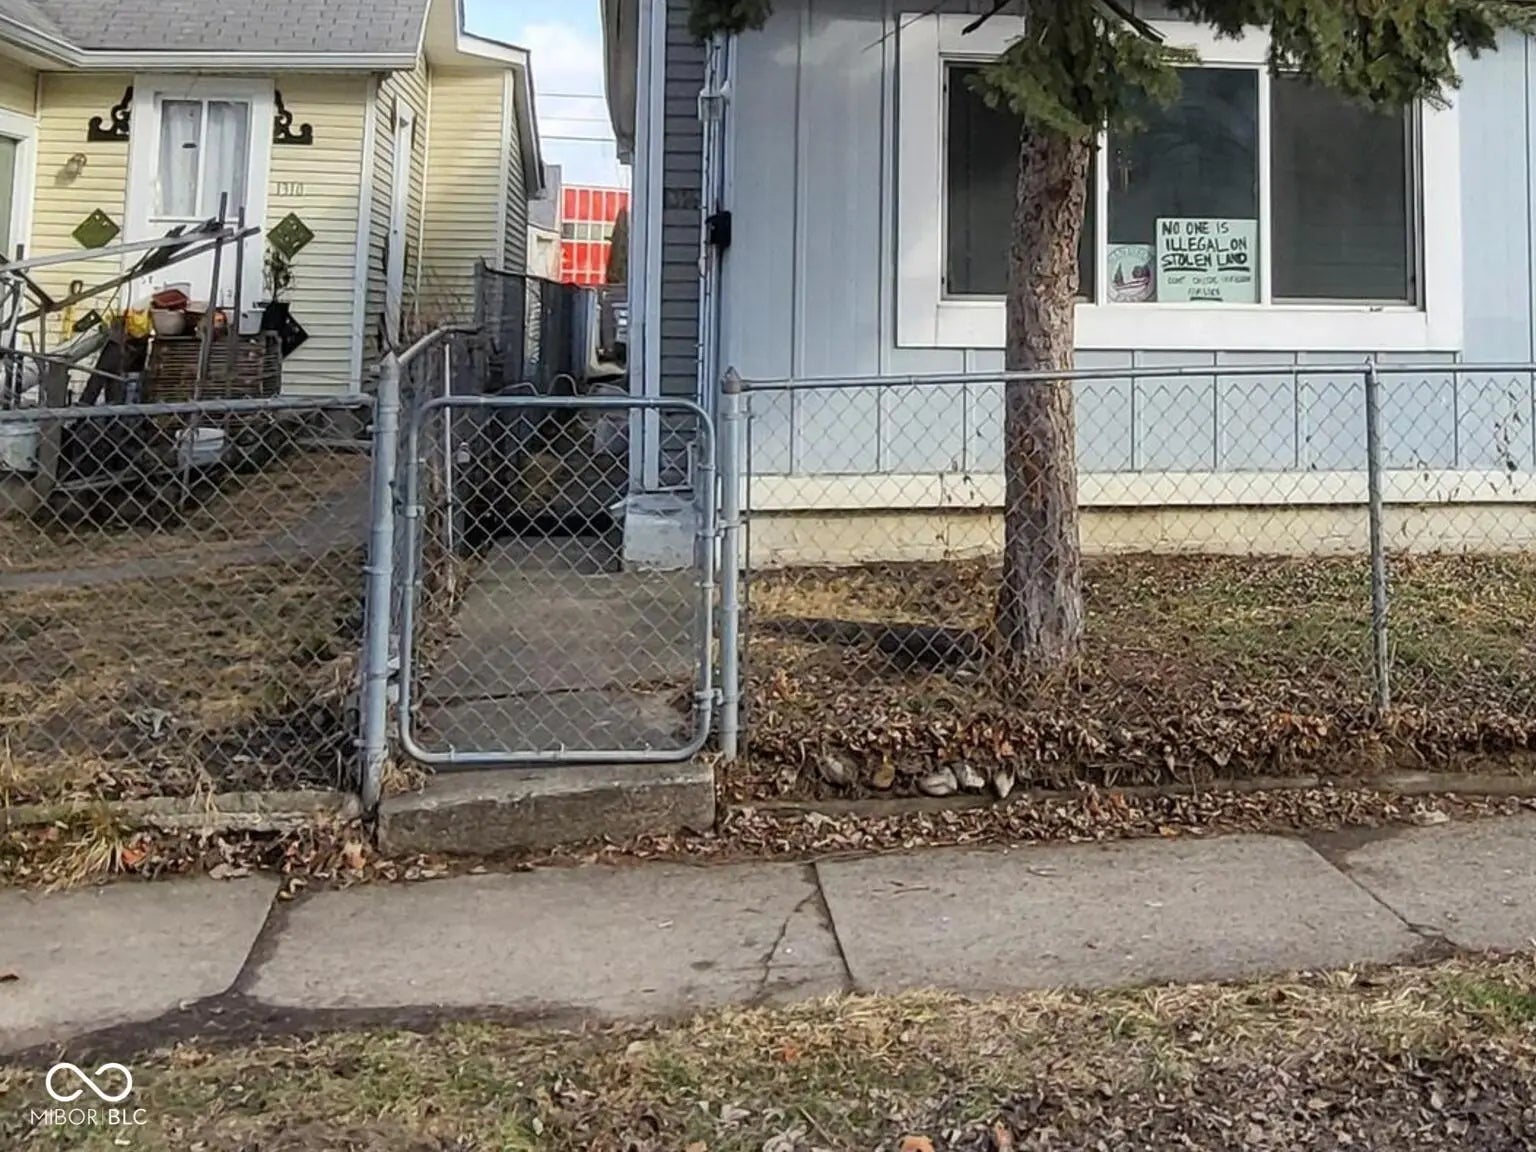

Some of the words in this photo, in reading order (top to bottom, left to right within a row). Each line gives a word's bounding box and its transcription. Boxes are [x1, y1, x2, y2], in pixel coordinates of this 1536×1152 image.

[1161, 221, 1180, 235] NO
[1186, 221, 1209, 235] ONE
[1217, 221, 1229, 235] IS
[1166, 237, 1229, 252] ILLEGAL
[1230, 236, 1247, 250] ON
[1161, 253, 1212, 268] STOLEN
[1217, 252, 1248, 266] LAND
